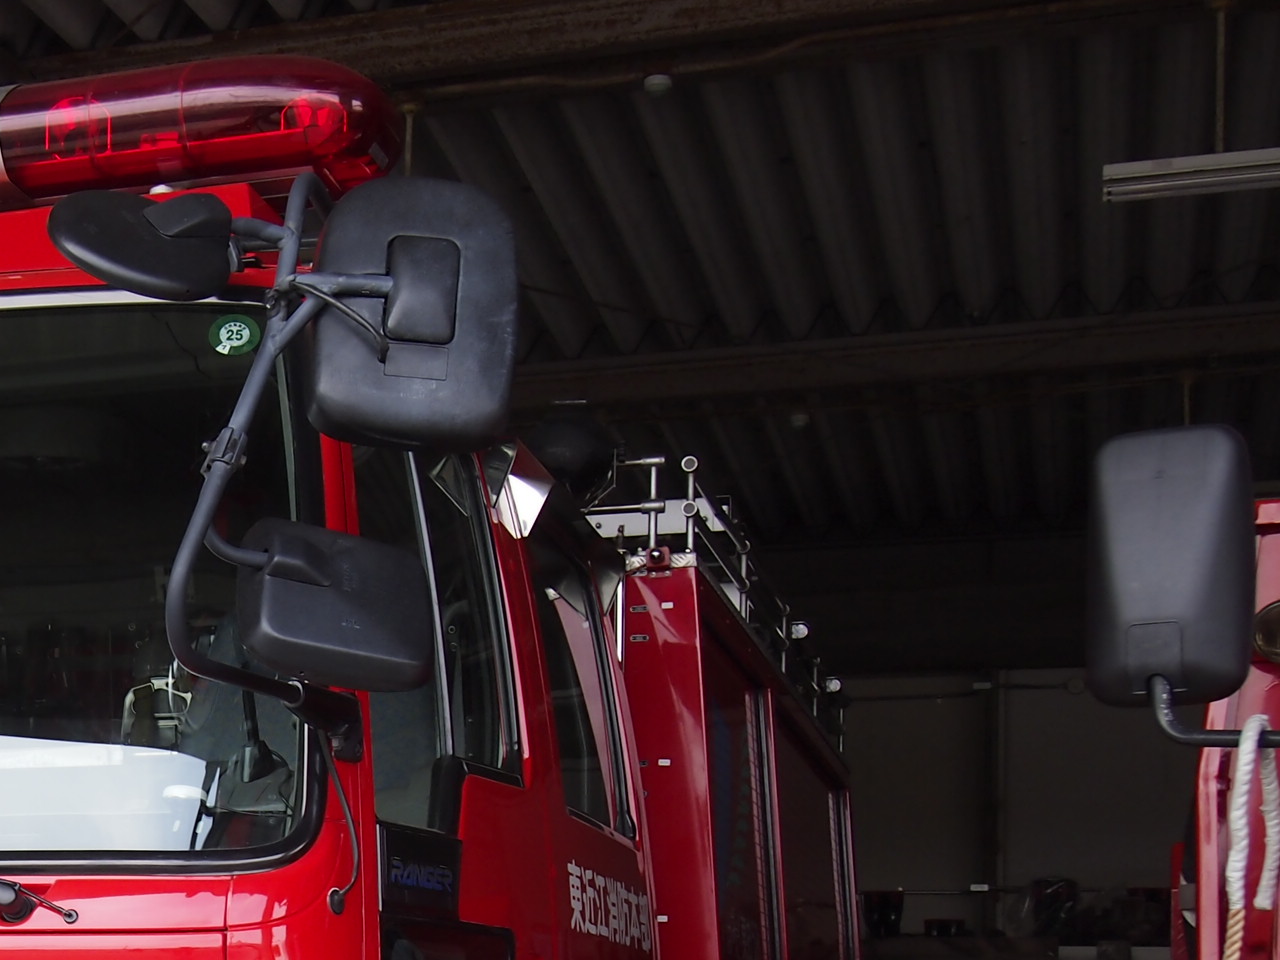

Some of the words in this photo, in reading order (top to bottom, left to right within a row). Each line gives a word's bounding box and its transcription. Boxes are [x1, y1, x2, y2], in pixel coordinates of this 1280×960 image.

[225, 329, 244, 341] 25
[391, 857, 452, 893] RANGER
[567, 859, 652, 953] 東近江消防本部
